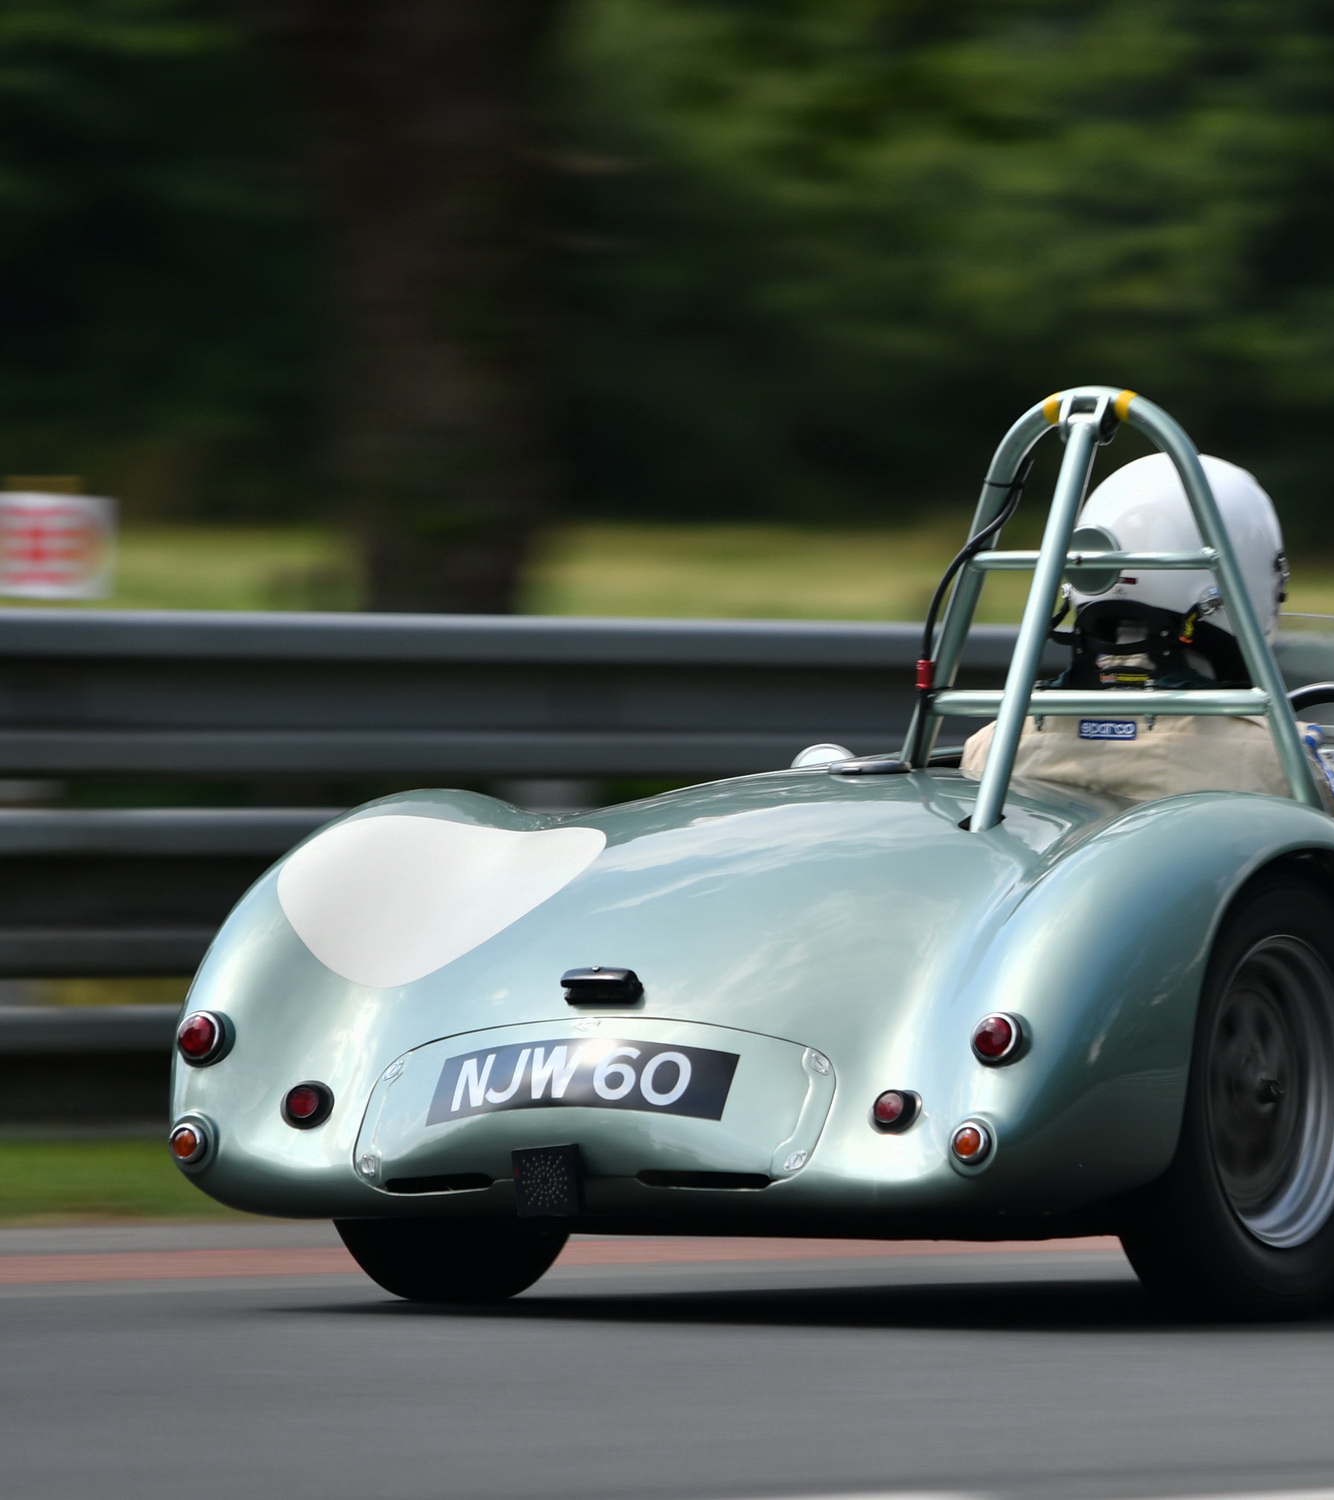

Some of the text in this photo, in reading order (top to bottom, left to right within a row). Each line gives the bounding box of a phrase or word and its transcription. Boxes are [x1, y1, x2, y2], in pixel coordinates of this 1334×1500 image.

[1080, 722, 1135, 736] sparco
[450, 1045, 692, 1112] NJW 60
